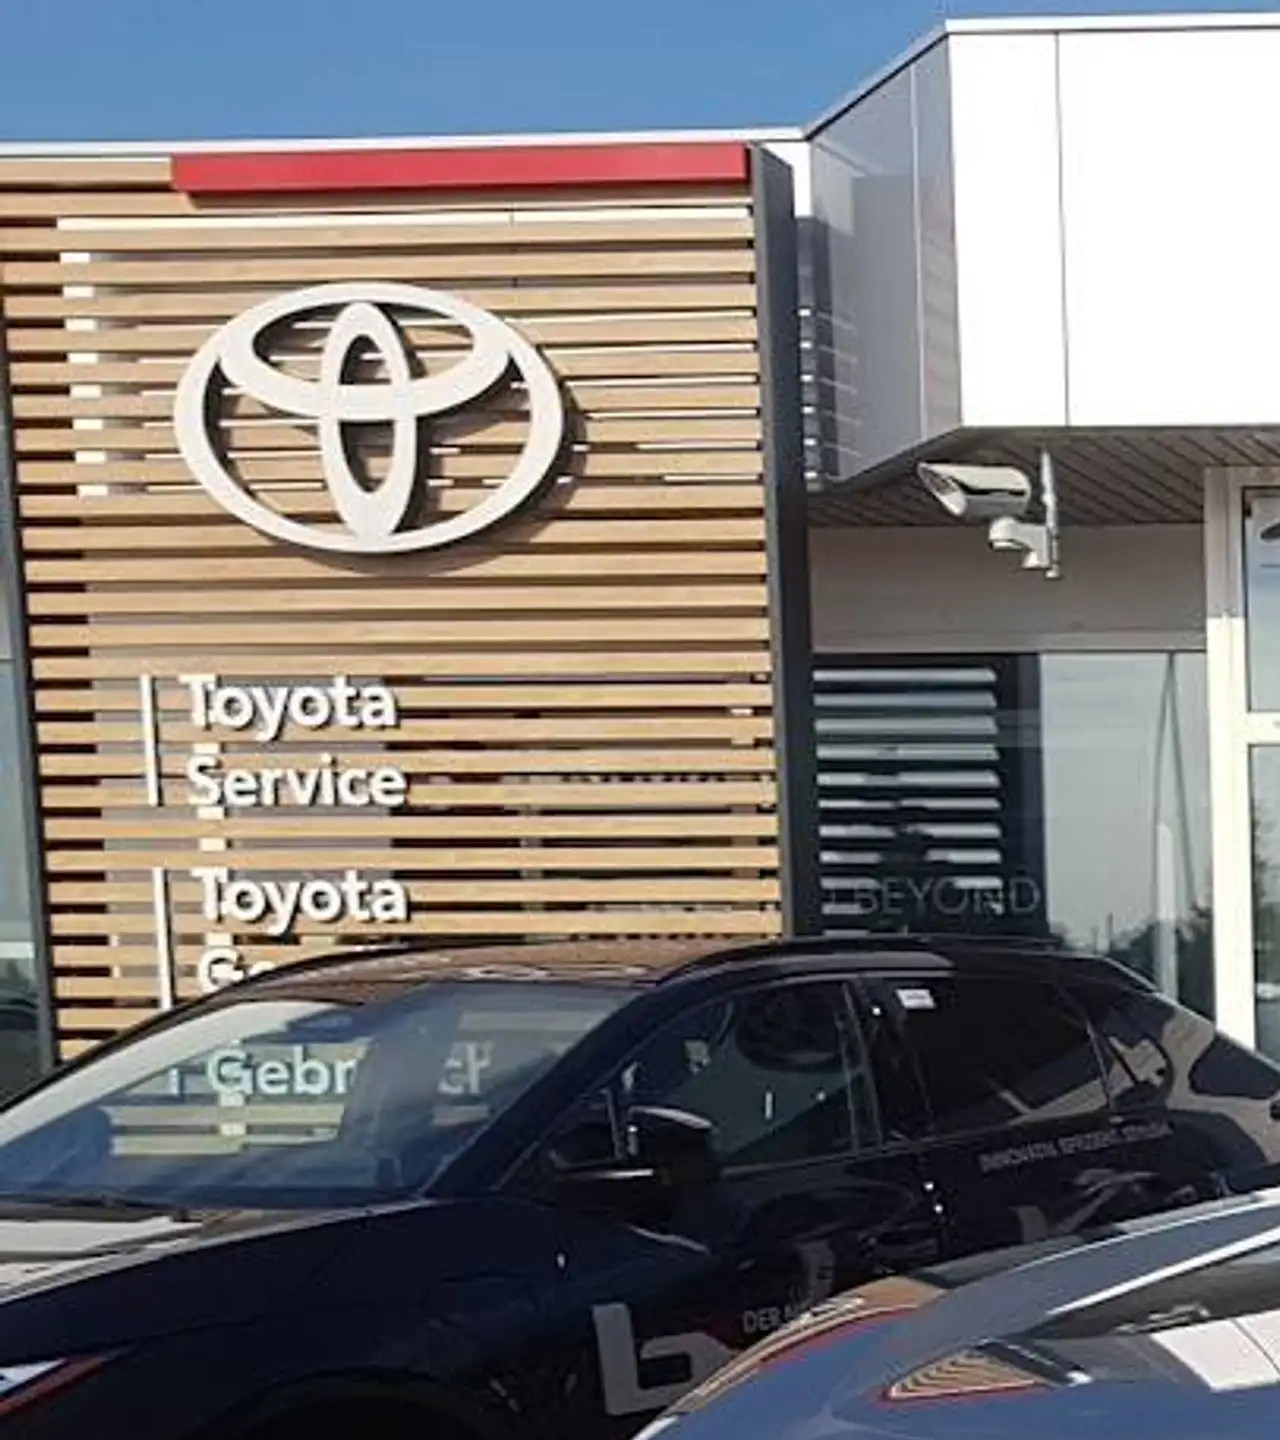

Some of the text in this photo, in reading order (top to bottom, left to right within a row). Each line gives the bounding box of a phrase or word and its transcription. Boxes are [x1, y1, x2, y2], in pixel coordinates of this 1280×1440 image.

[179, 674, 396, 741] Toyota
[186, 753, 406, 806] Service
[191, 868, 407, 936] Toyota
[854, 876, 1041, 914] BEYOND
